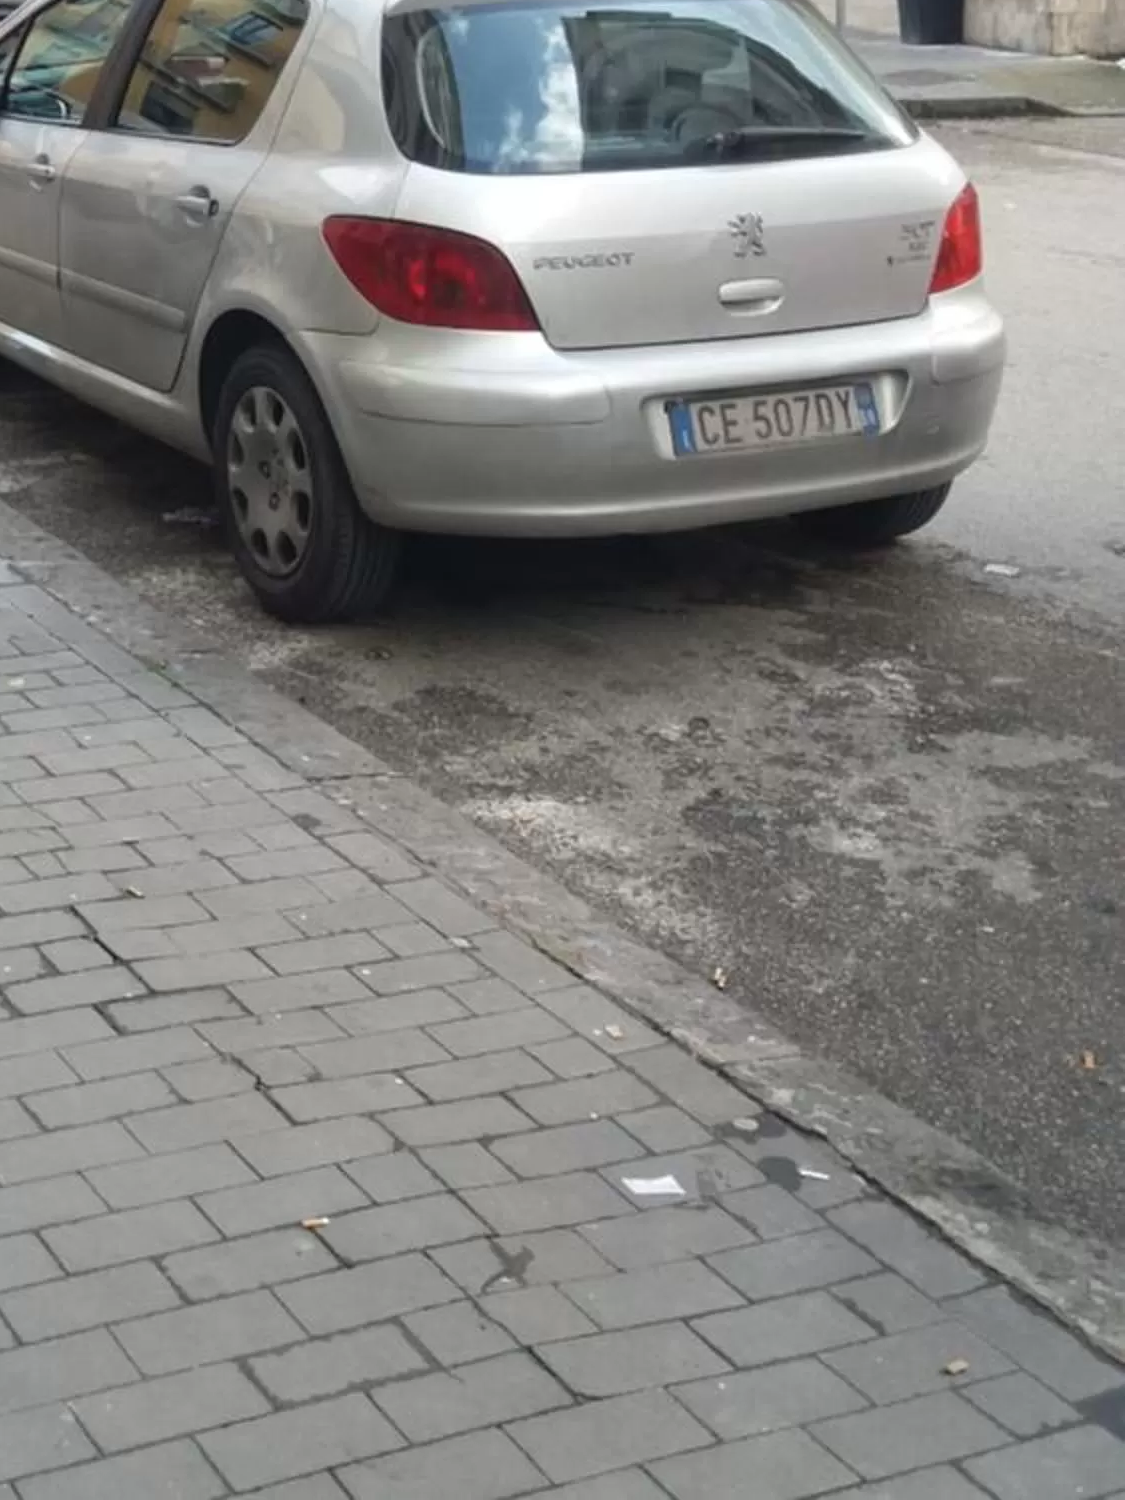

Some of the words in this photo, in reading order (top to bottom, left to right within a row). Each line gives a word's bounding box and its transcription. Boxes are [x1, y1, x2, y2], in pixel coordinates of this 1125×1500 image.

[533, 251, 636, 271] PEUGEOT
[697, 403, 743, 445] CE
[752, 389, 853, 440] 507DY
